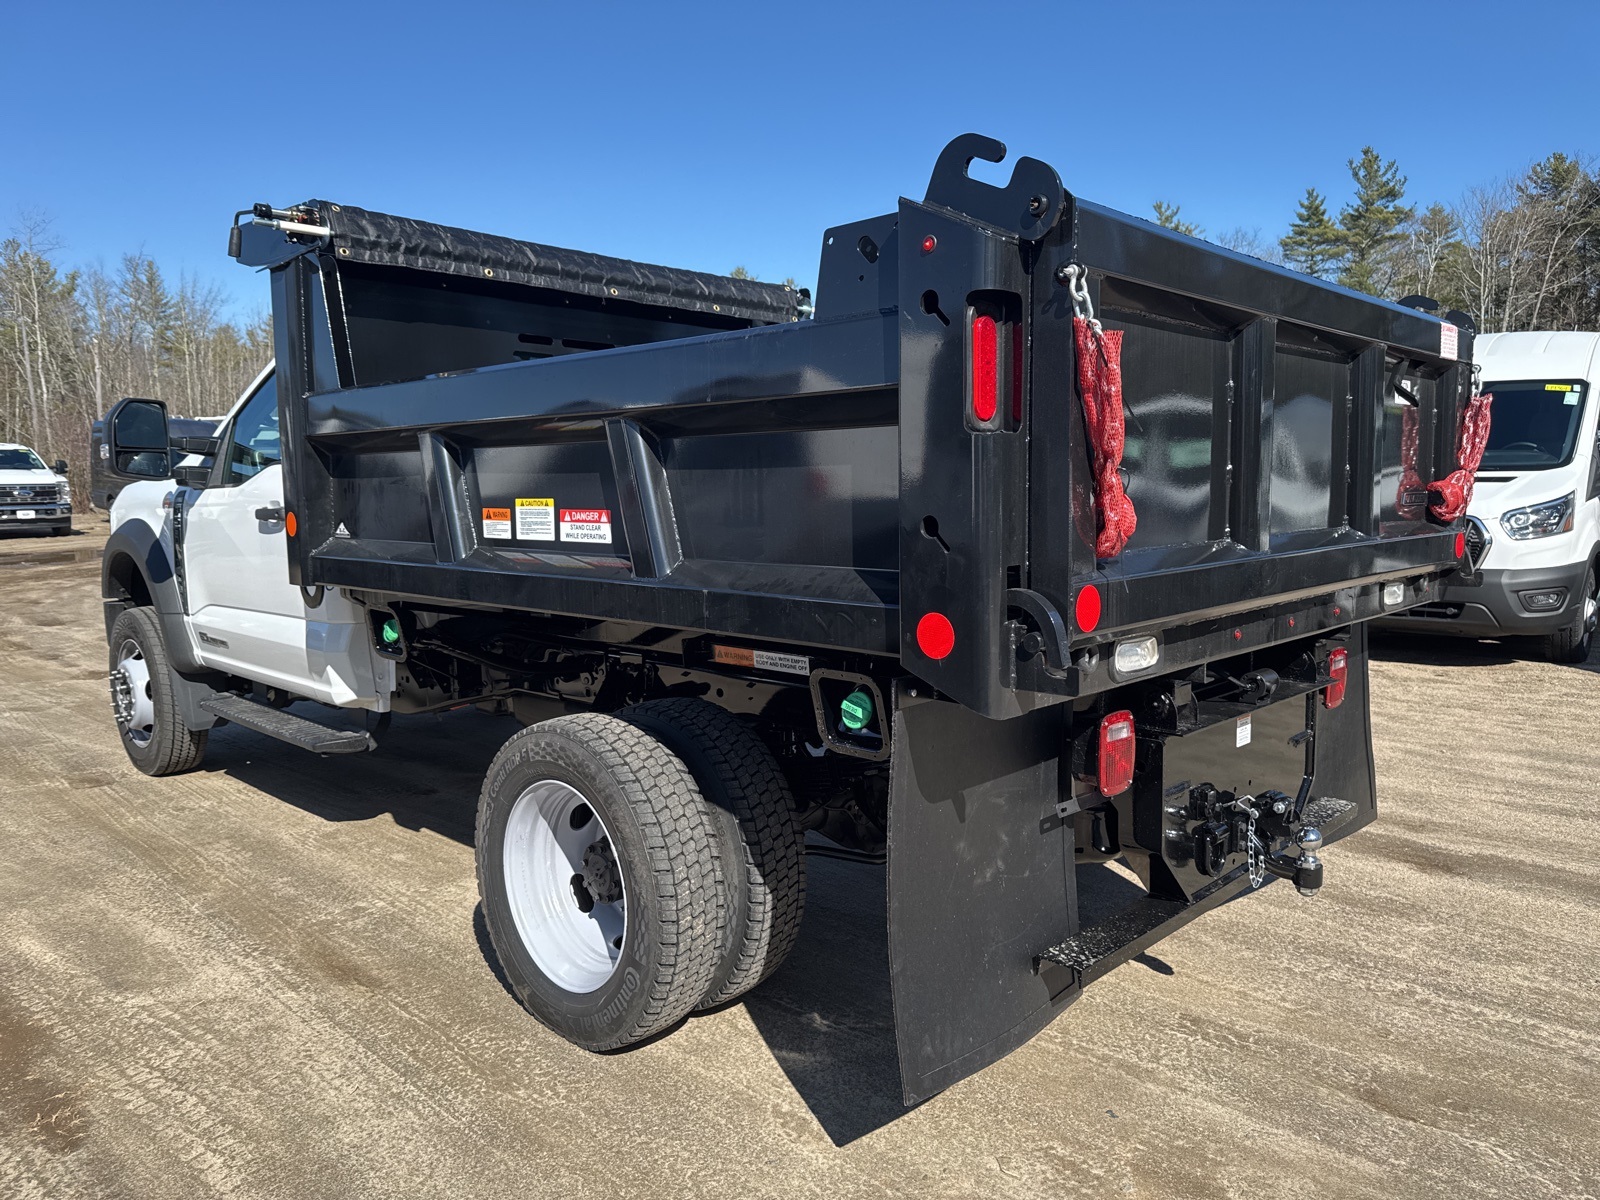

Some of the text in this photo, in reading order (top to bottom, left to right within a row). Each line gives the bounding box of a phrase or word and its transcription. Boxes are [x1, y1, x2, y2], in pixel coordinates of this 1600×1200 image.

[572, 511, 599, 521] DANGER
[585, 524, 601, 532] CLEAR
[580, 533, 607, 541] OPERATING
[723, 651, 753, 662] WARNING
[790, 657, 807, 665] EMPTY
[490, 747, 527, 798] Conti HDR 5
[579, 966, 641, 1036] Continental
